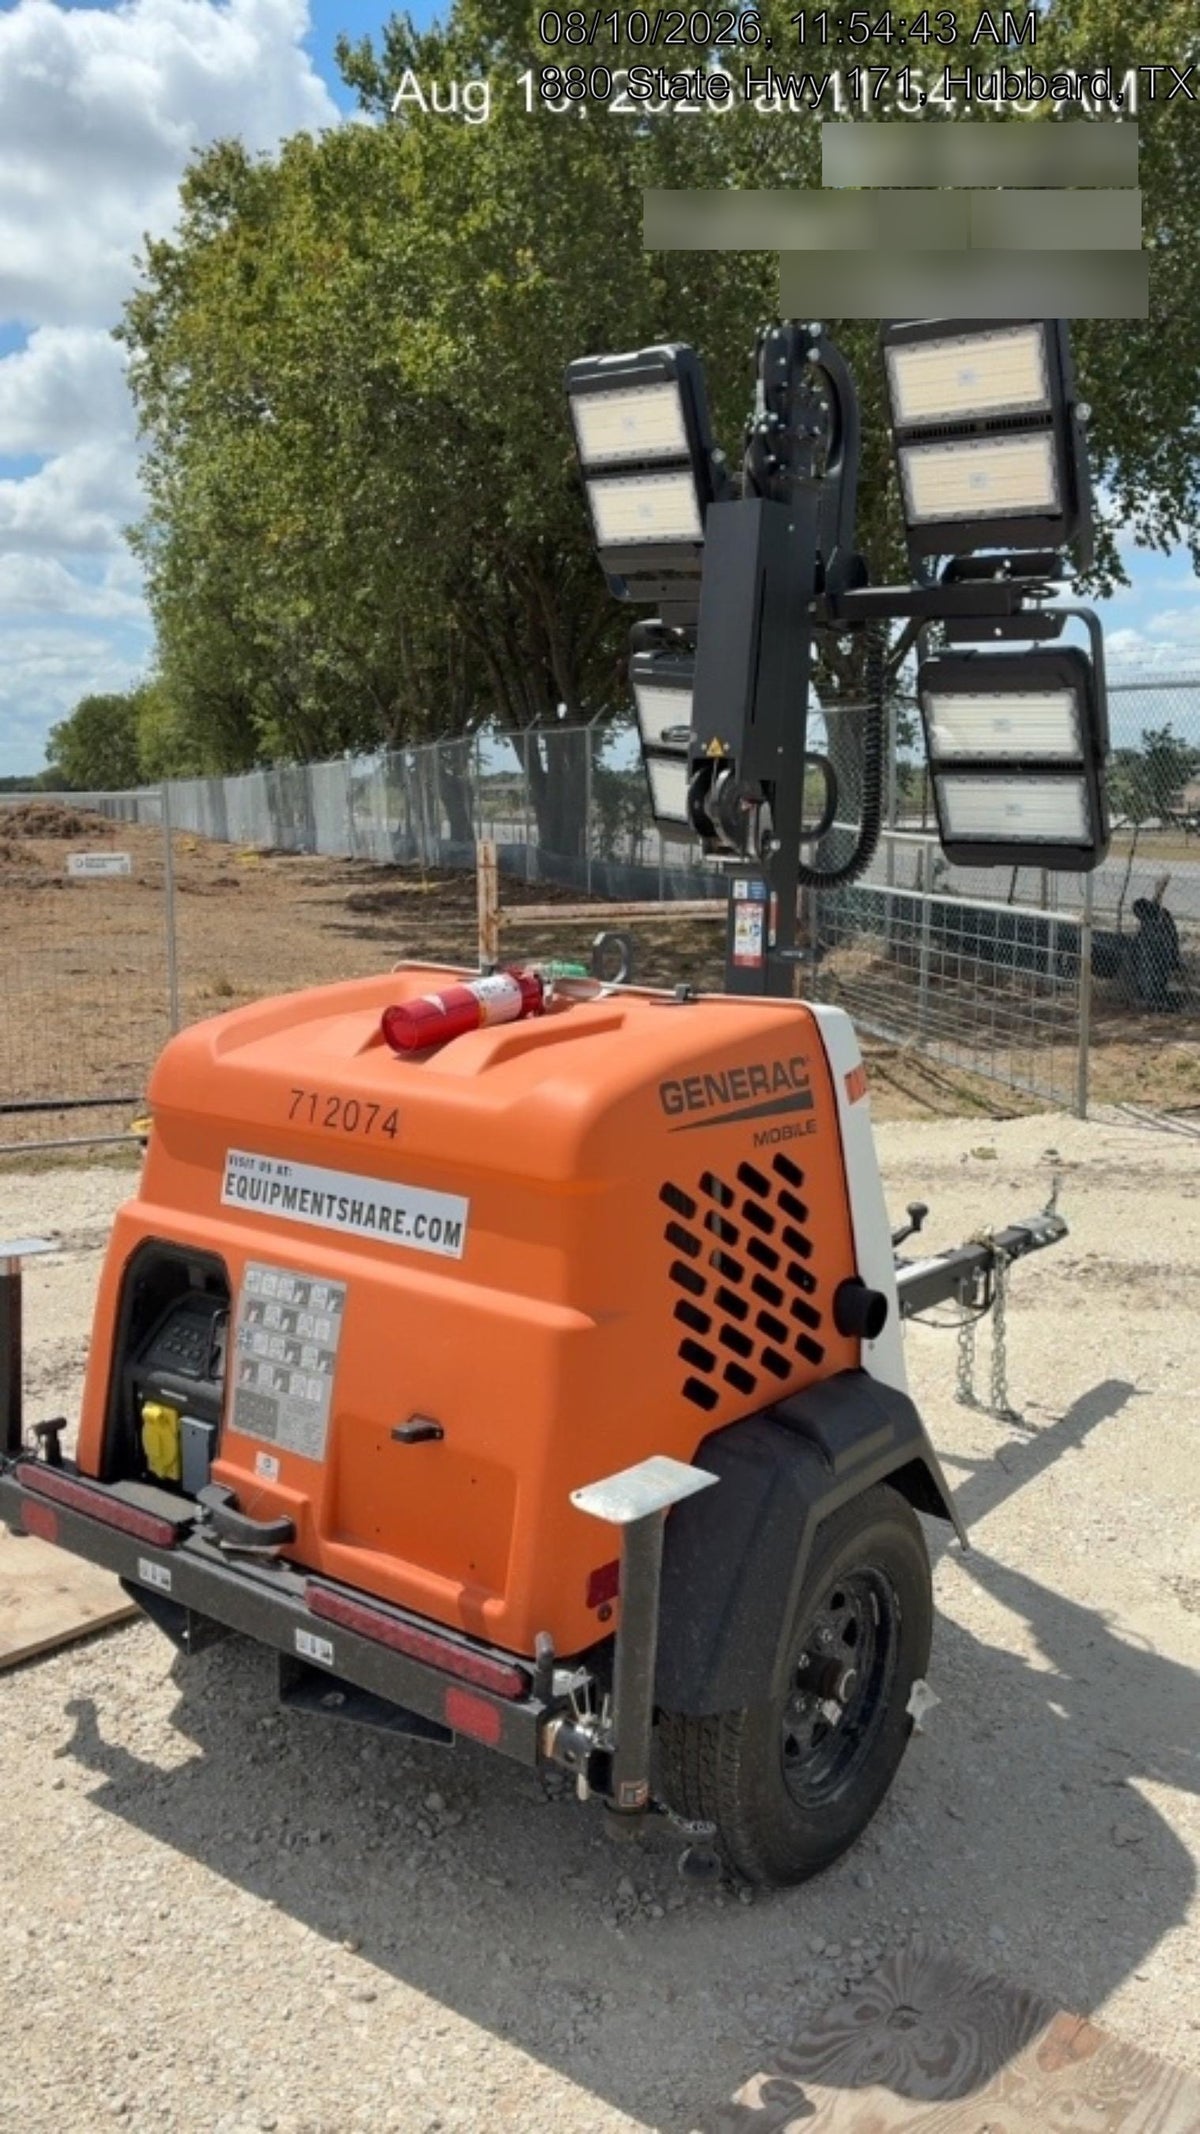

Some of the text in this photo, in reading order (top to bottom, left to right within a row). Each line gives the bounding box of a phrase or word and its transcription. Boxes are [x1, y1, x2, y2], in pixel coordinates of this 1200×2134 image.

[658, 1056, 810, 1116] GENERAC
[288, 1089, 400, 1140] 712074
[753, 1118, 817, 1148] MOBILE
[225, 1173, 462, 1248] EQUIPMENTSHARE.COM
